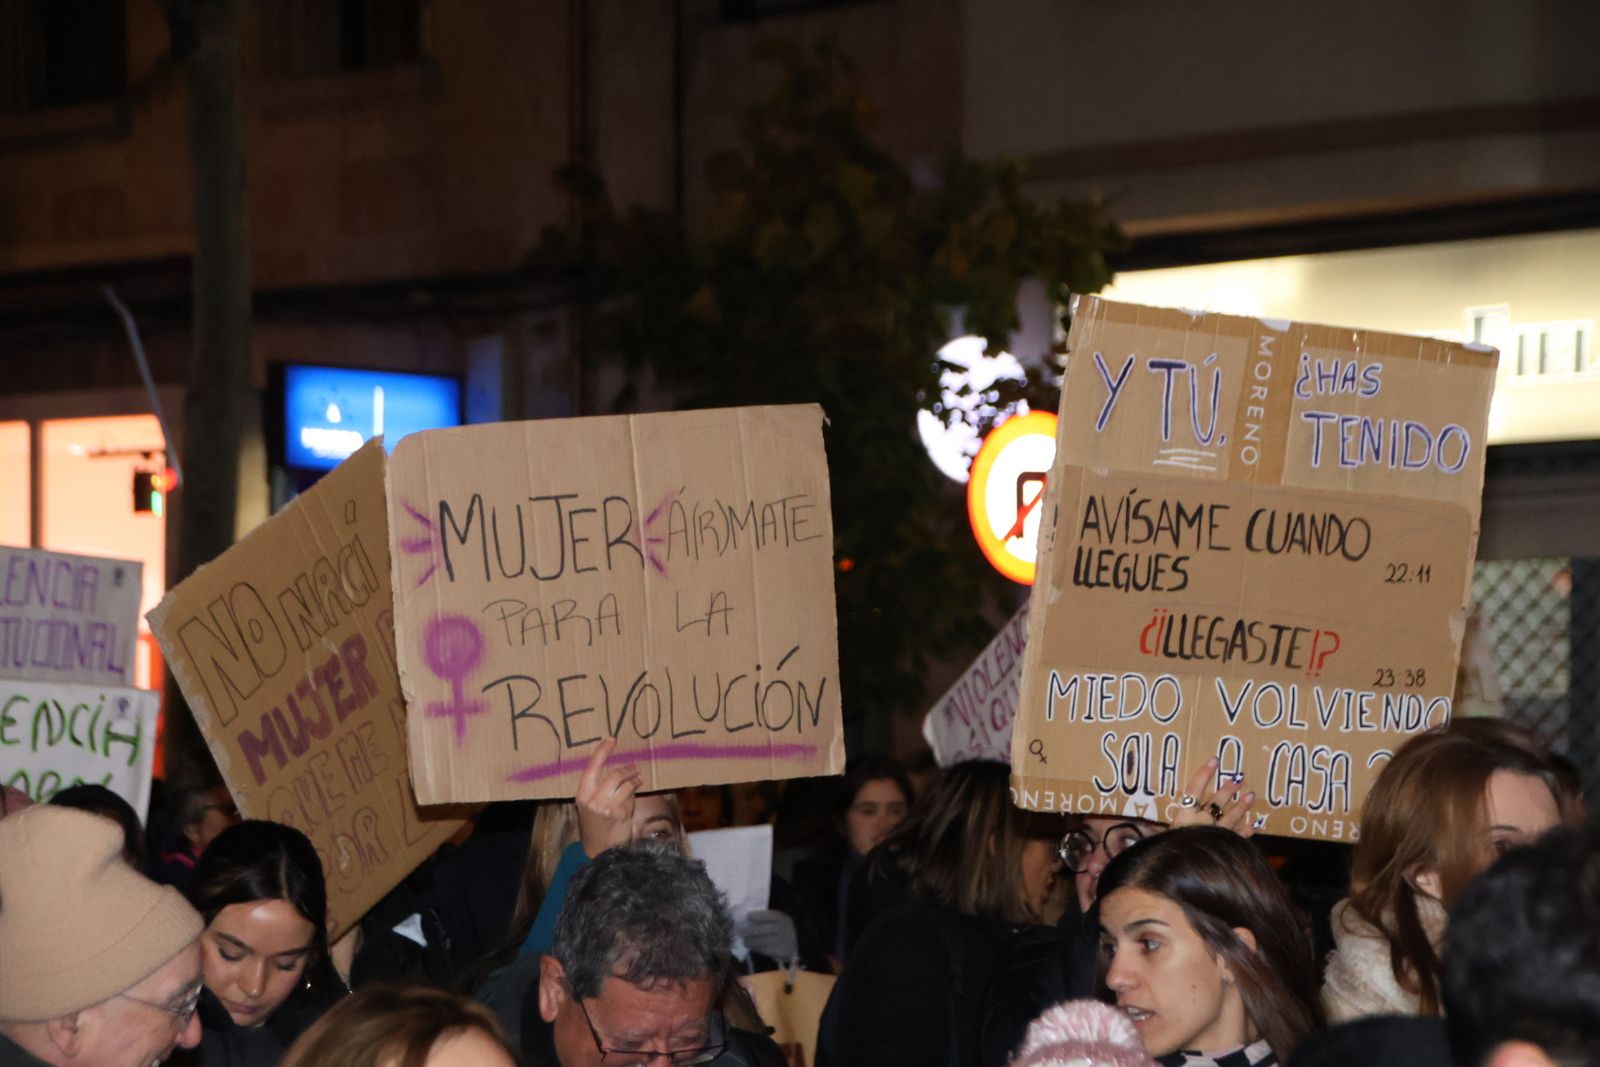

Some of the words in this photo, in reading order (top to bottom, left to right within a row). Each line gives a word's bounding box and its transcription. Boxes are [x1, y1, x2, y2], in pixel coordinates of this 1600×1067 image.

[1093, 351, 1135, 431] Y
[1295, 353, 1383, 400] ¿HAS
[1241, 335, 1277, 465] MORENO
[1304, 412, 1471, 475] TENIDO
[439, 494, 645, 582] MUJER
[1080, 488, 1232, 552] AVÍSAME
[1246, 507, 1372, 561] CUANDO
[0, 555, 99, 614] ENCIA
[1073, 545, 1190, 593] LLEGUES
[1384, 563, 1431, 583] 22:11
[178, 581, 286, 727] NO
[482, 593, 621, 646] PARA
[675, 591, 735, 637] LA
[237, 633, 379, 787] MUJER
[1046, 670, 1183, 724] MIEDO
[1215, 677, 1452, 734] VOLVIENDO
[1092, 732, 1182, 798] SOLA
[1215, 735, 1244, 801] A
[1267, 739, 1354, 816] CASA
